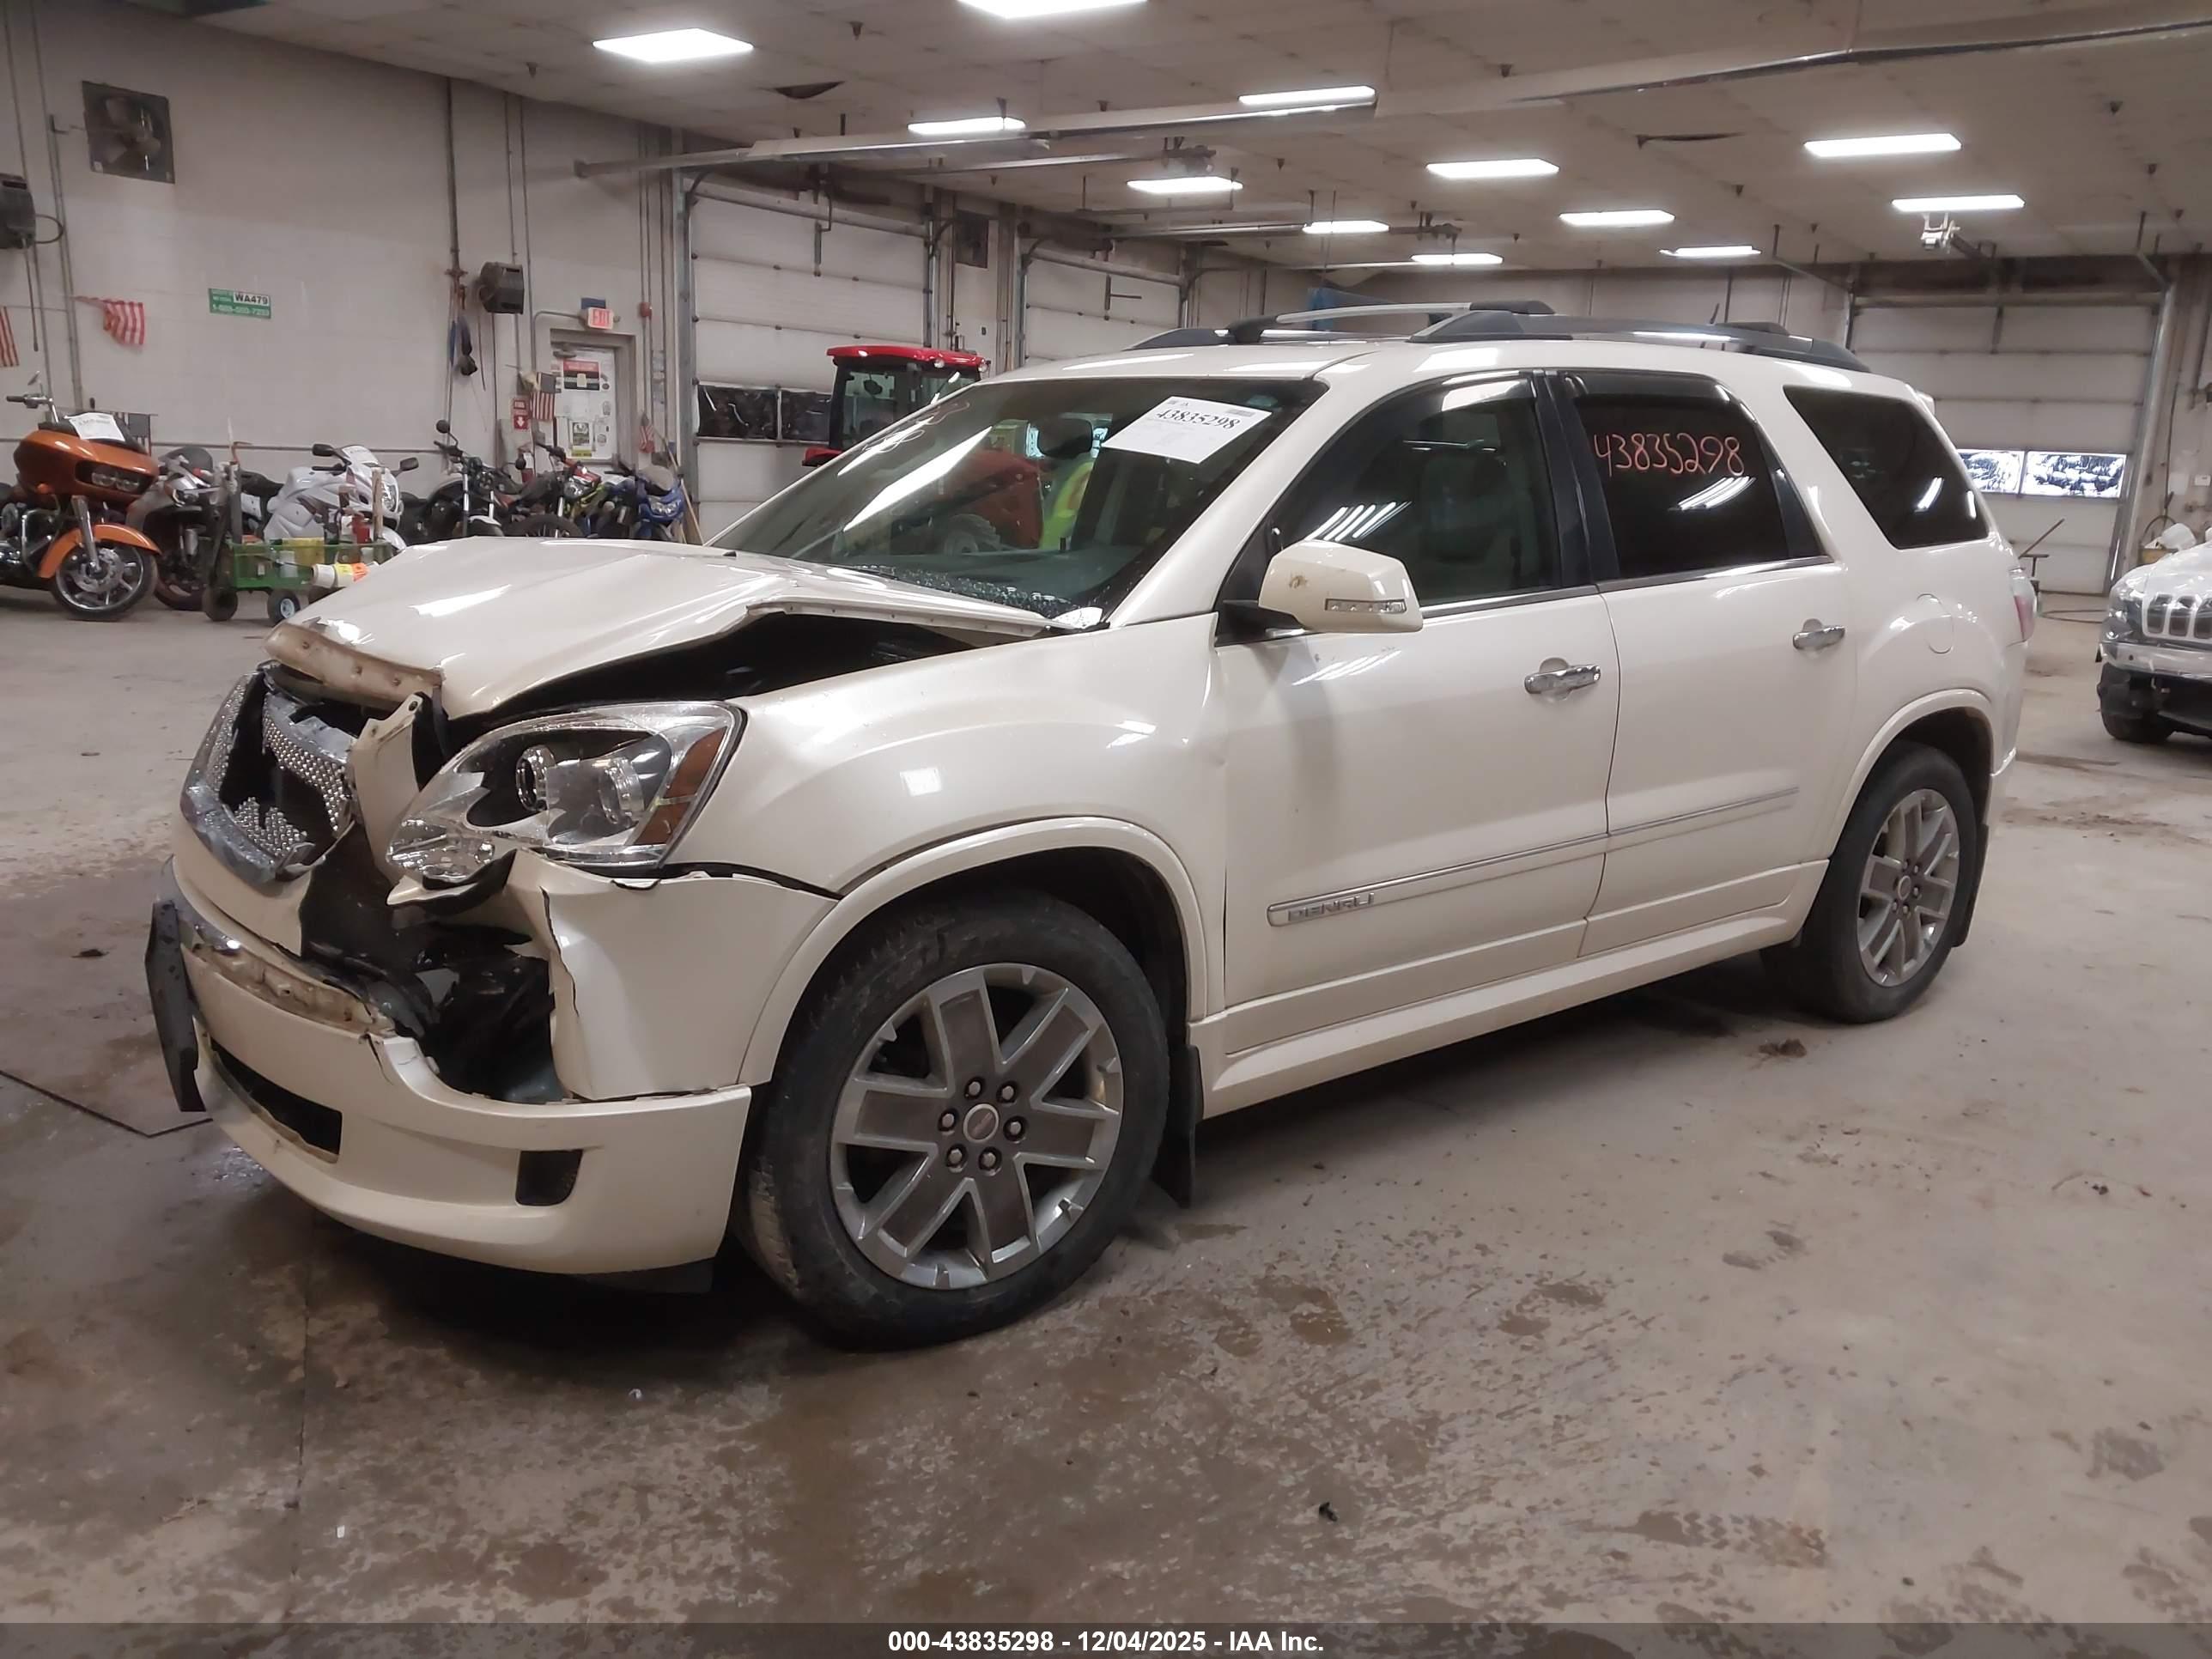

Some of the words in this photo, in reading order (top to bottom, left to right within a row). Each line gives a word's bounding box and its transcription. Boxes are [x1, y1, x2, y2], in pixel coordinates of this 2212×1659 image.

[234, 294, 269, 305] WA479
[1156, 408, 1242, 429] 43835298
[1594, 432, 1745, 477] 43835298
[1287, 892, 1375, 921] DENALI
